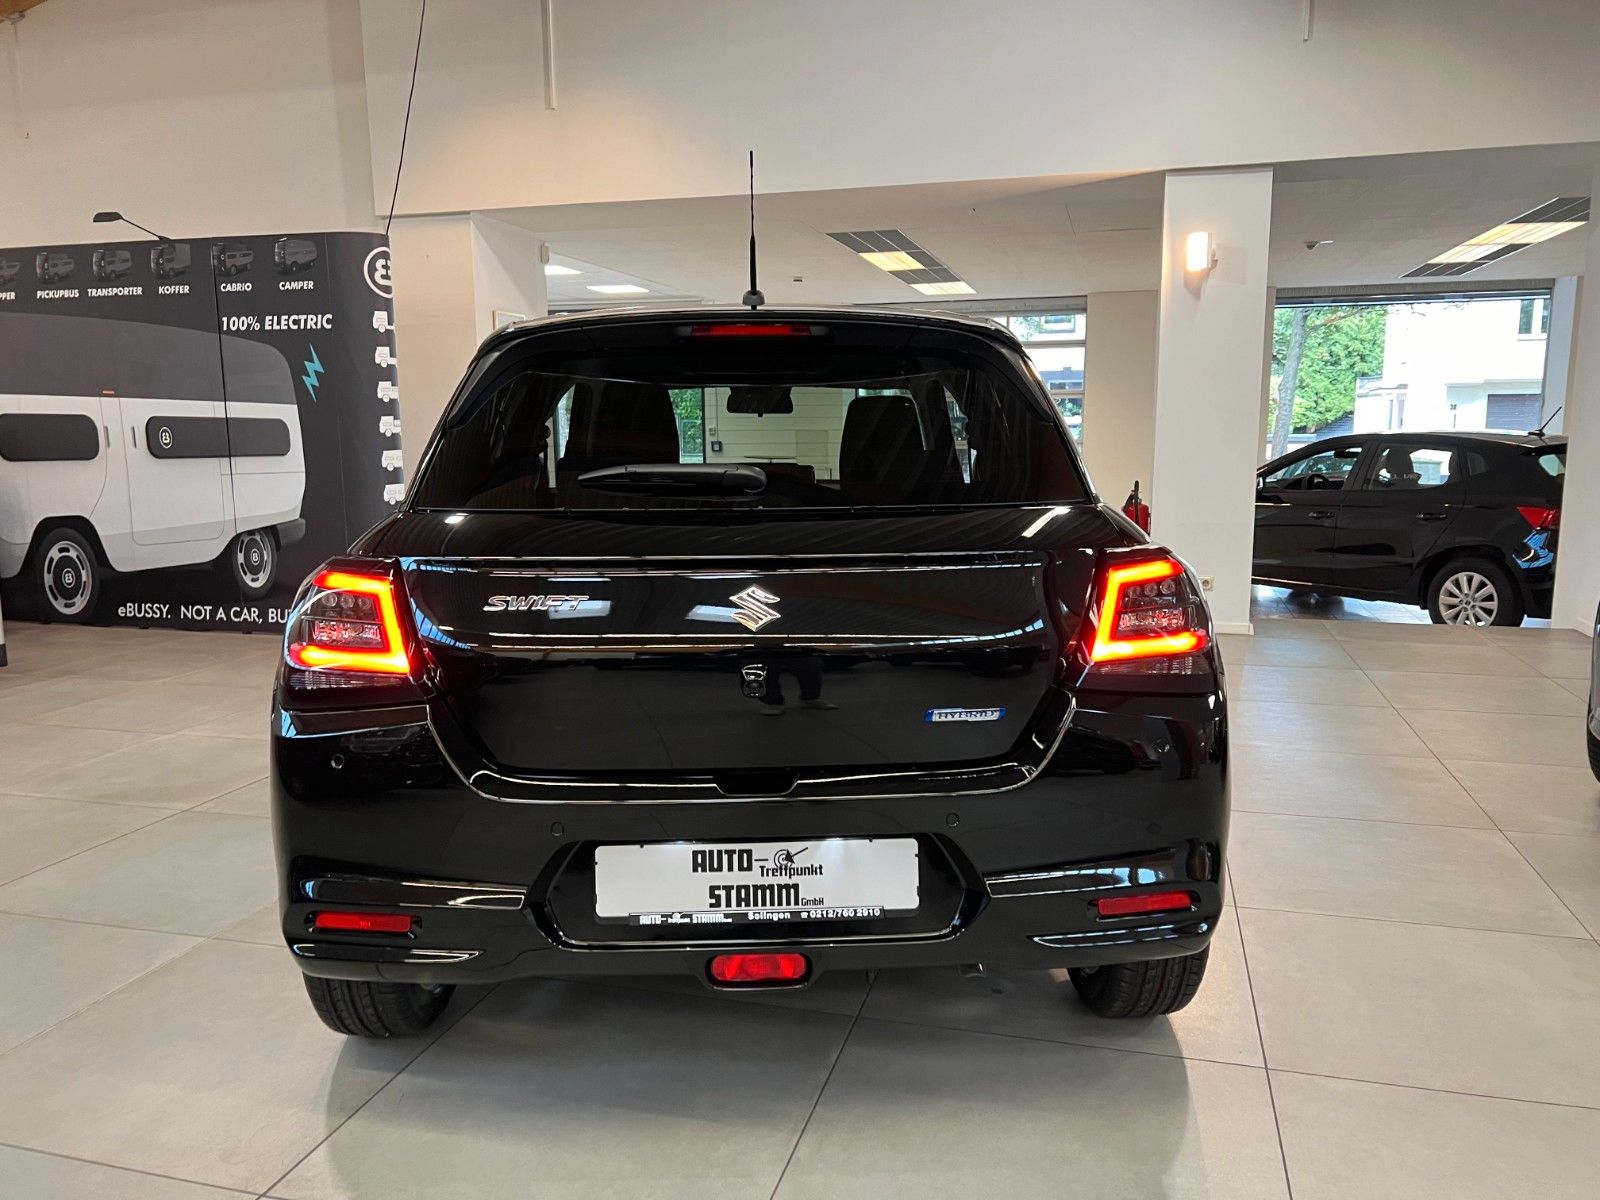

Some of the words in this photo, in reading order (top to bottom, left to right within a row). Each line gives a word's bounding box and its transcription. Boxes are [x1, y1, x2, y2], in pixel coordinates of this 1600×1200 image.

[158, 285, 190, 294] KOFFER
[220, 282, 253, 292] CABRIO
[279, 280, 314, 290] CAMPER
[36, 289, 79, 299] PICKUPBUS
[87, 287, 143, 297] TRANSPORTER
[221, 315, 260, 331] 100%
[264, 314, 333, 330] ELECTRIC
[483, 595, 590, 612] SWIFT
[118, 602, 171, 619] eBUSSY.
[180, 605, 212, 620] NOT
[216, 607, 226, 621] A
[230, 606, 263, 624] CAR,
[759, 864, 823, 879] Treffpunkt
[708, 883, 800, 908] STAMM
[801, 897, 824, 907] GmbH
[747, 911, 791, 921] Solingen
